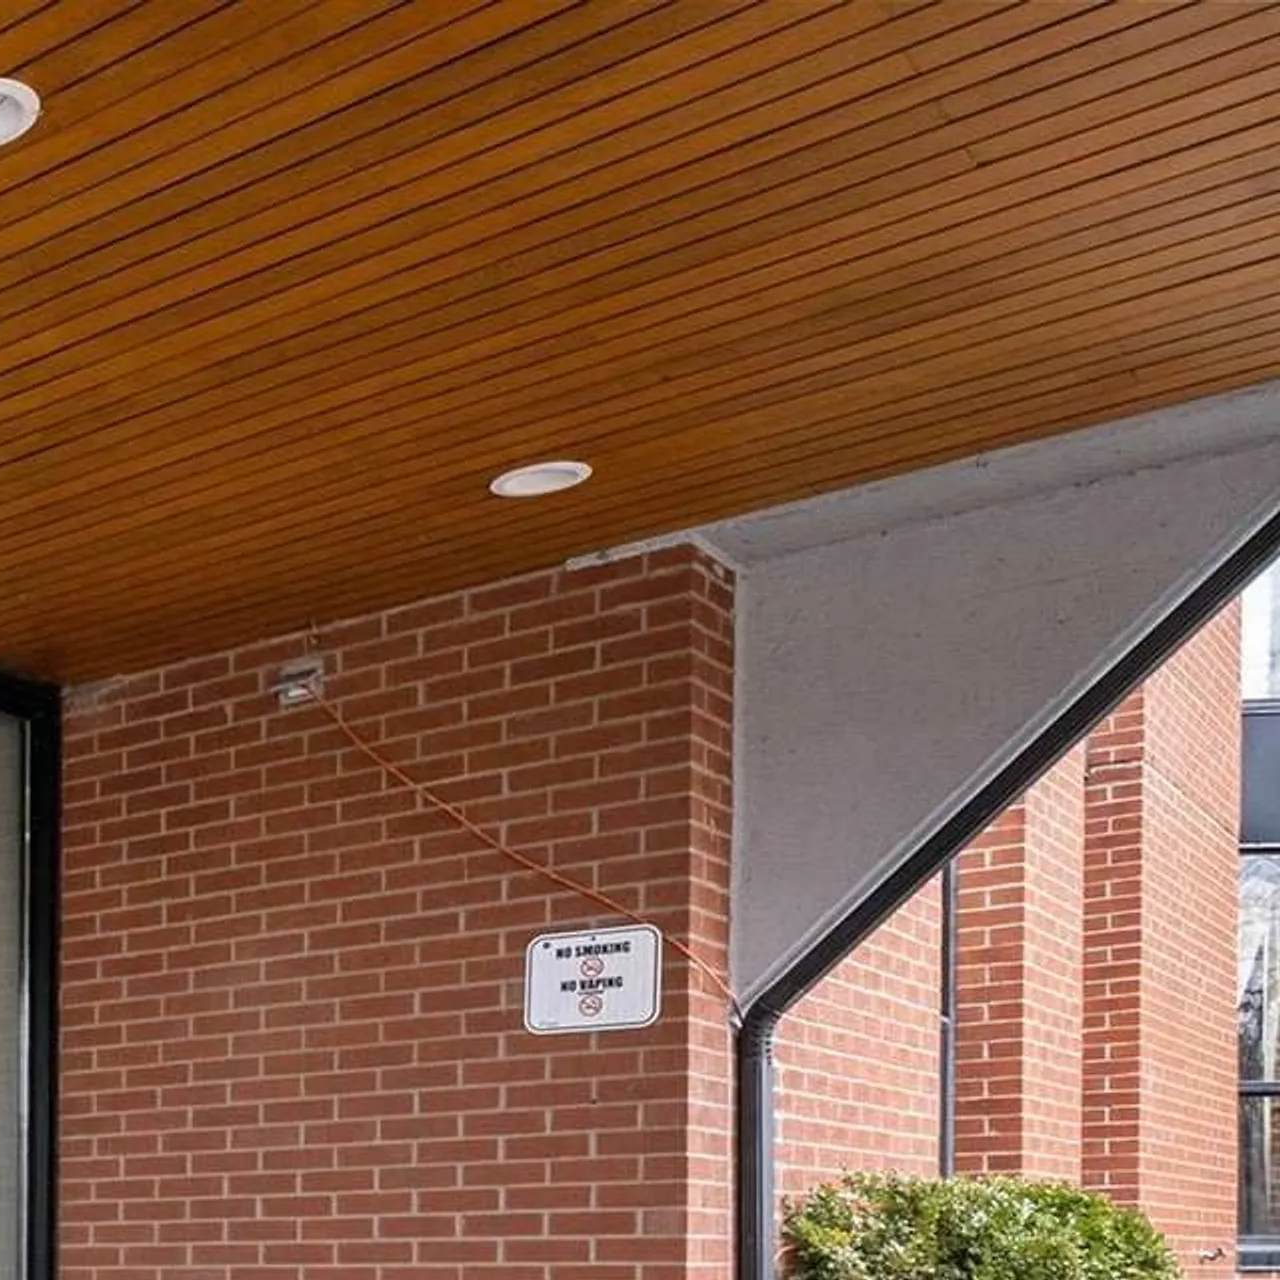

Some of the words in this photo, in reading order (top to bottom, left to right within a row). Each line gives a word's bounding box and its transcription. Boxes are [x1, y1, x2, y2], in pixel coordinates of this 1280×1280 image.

[556, 947, 572, 959] NO
[575, 941, 630, 957] SMOKING
[560, 980, 577, 992] NO
[580, 976, 623, 990] VAPING
